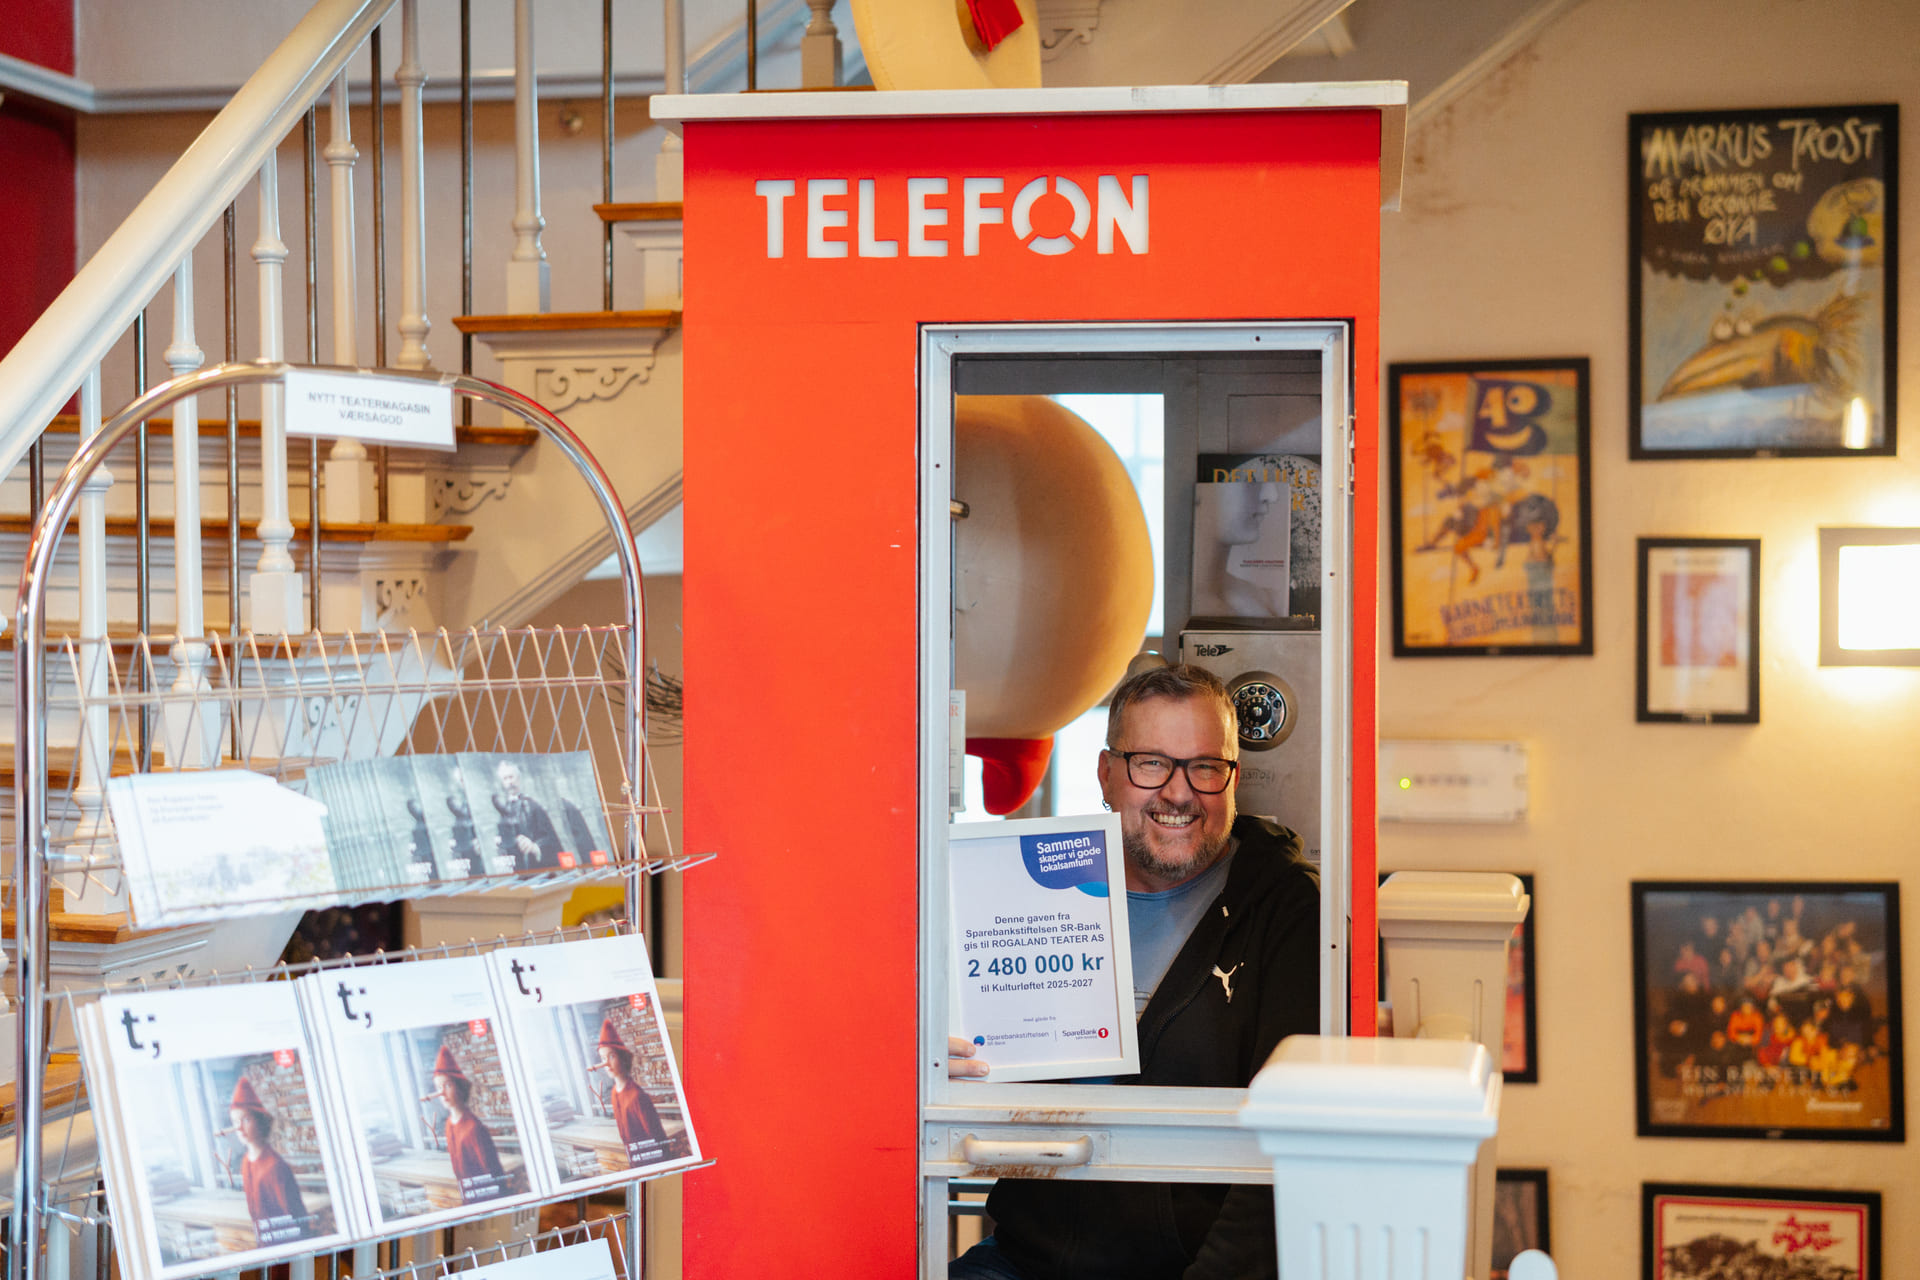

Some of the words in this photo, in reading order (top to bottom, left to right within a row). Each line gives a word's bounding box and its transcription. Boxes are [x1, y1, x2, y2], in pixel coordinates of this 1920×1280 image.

[1643, 123, 1772, 178] MARKUS
[1779, 117, 1881, 170] TROST
[755, 174, 1149, 259] TELEFON
[308, 392, 336, 404] NYTT
[340, 395, 431, 414] TEATERMAGASIN
[1194, 644, 1217, 656] Tele
[1036, 836, 1090, 854] Sammen
[1038, 852, 1066, 864] skaper
[1068, 850, 1076, 858] vi
[1077, 846, 1101, 858] gode
[1040, 858, 1093, 872] lokalsamfunn
[994, 916, 1024, 924] Denne
[1027, 914, 1055, 924] gaven
[1058, 912, 1070, 920] fra
[965, 925, 1058, 939] Sparebankstiftelsen
[1060, 922, 1102, 932] SR-Bank
[964, 942, 978, 952] gis
[980, 940, 990, 948] til
[992, 937, 1048, 948] ROGALAND
[1050, 934, 1088, 944] TEATER
[1090, 934, 1105, 942] AS
[968, 959, 980, 978] 2
[988, 956, 1027, 976] 480
[1035, 954, 1074, 974] 000
[1082, 952, 1104, 971] kr
[980, 984, 990, 992] til
[992, 981, 1044, 992] Kulturløftet
[1047, 978, 1093, 989] 2025-2027
[1062, 1028, 1097, 1038] SpareBank
